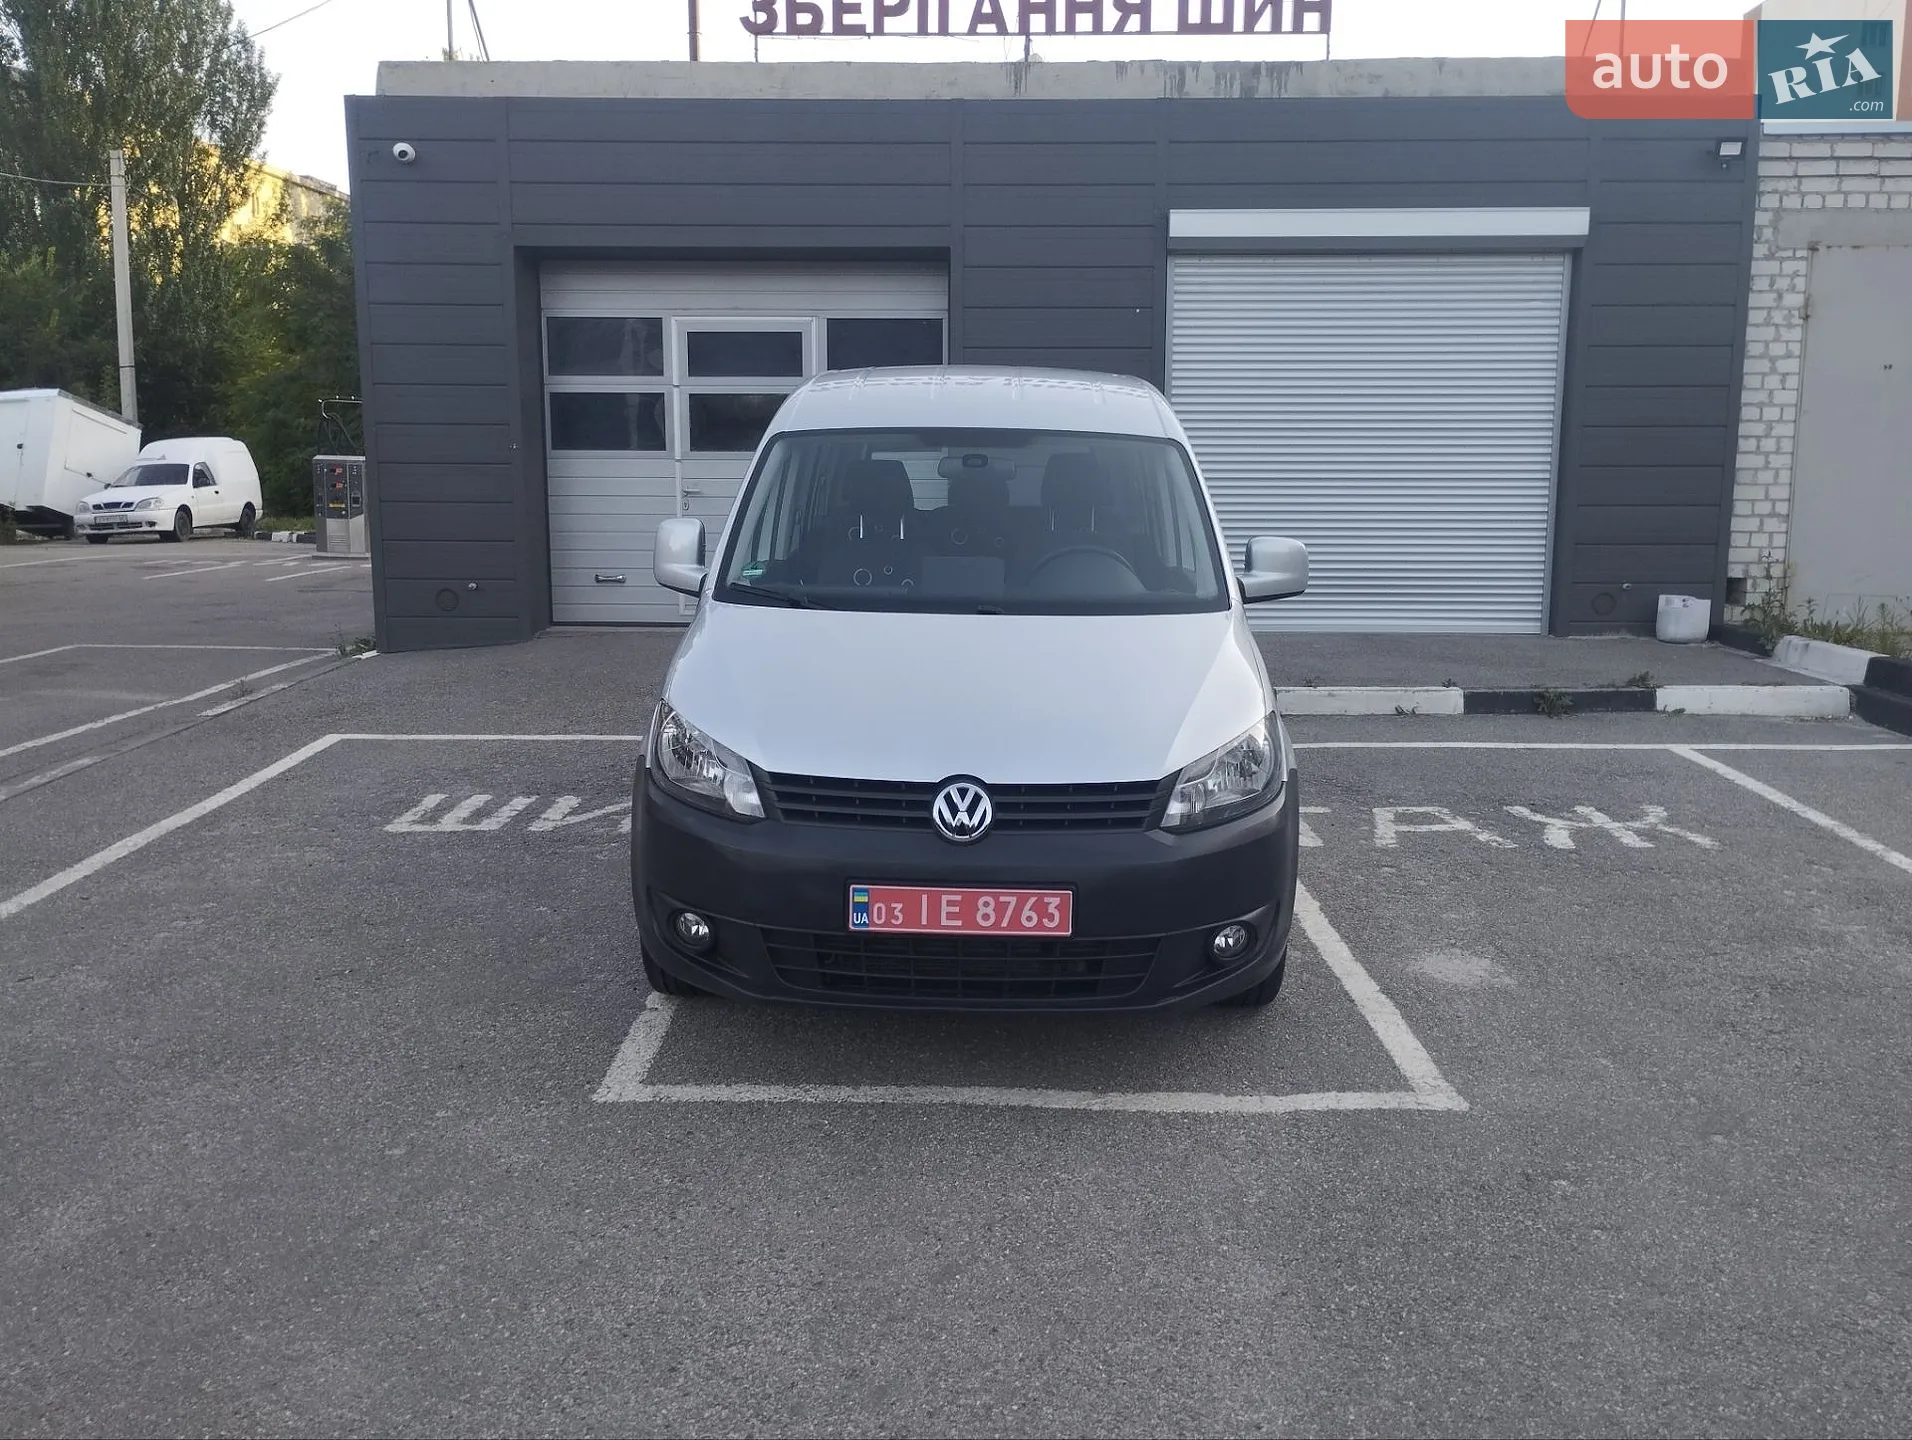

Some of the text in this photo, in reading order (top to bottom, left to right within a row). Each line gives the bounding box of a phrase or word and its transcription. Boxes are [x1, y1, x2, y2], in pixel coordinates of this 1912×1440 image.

[1178, 0, 1332, 34] ШИН
[853, 893, 1061, 928] UA 03 IE 8763
